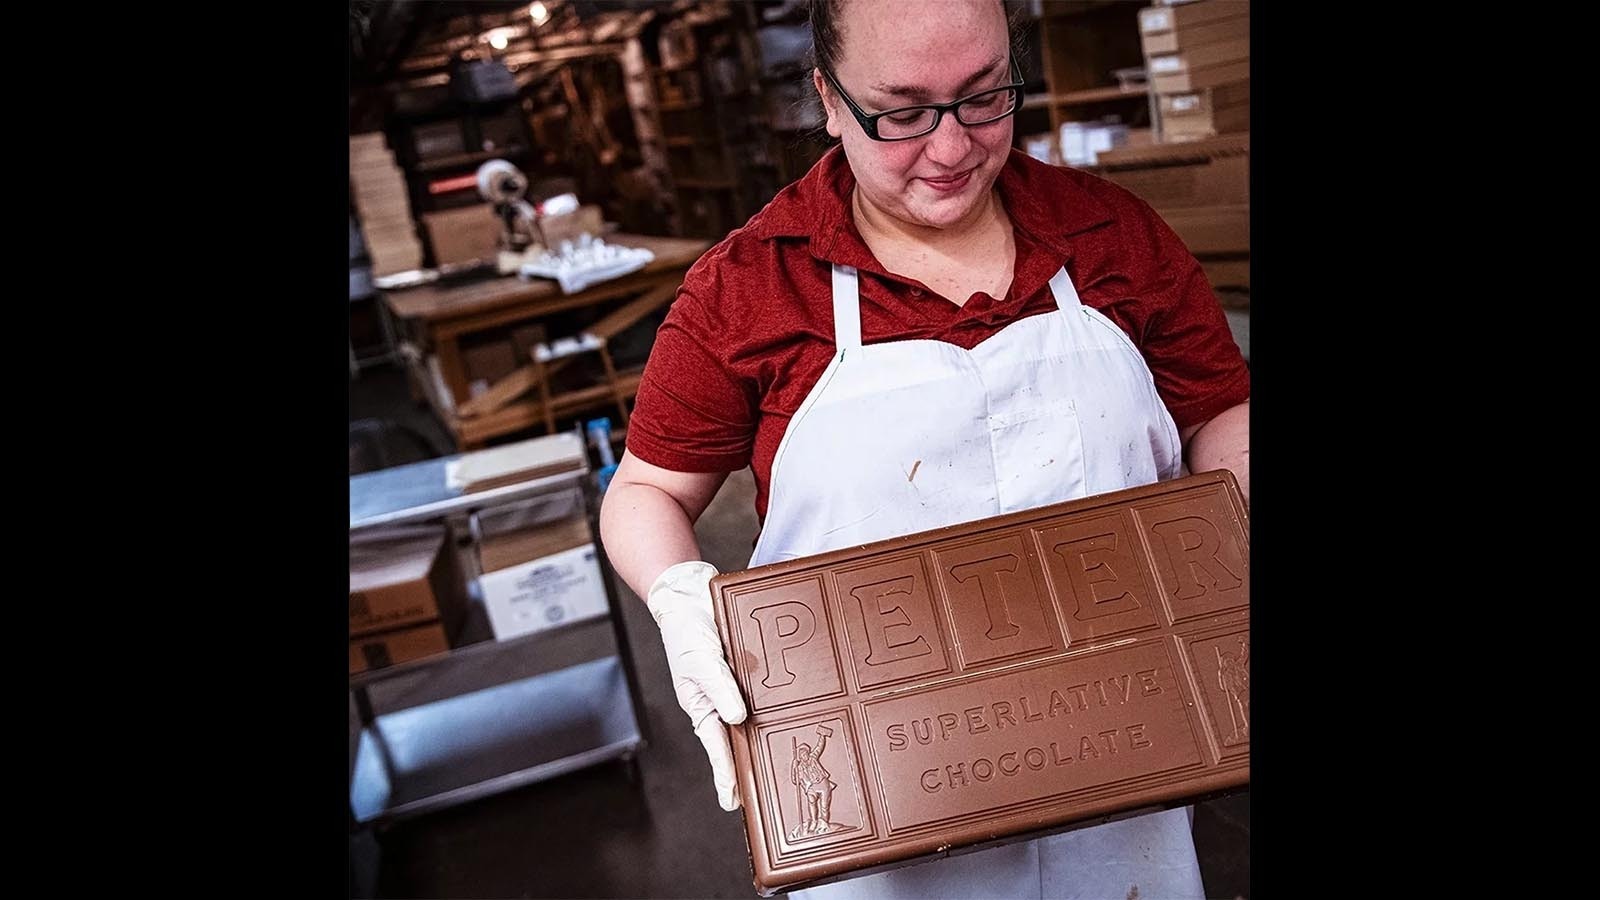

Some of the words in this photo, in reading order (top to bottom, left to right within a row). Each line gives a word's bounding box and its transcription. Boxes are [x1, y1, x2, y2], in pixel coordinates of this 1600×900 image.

[750, 516, 1243, 688] PETER
[886, 669, 1164, 751] SUPERLATIVE
[920, 723, 1152, 793] CHOCOLATE
